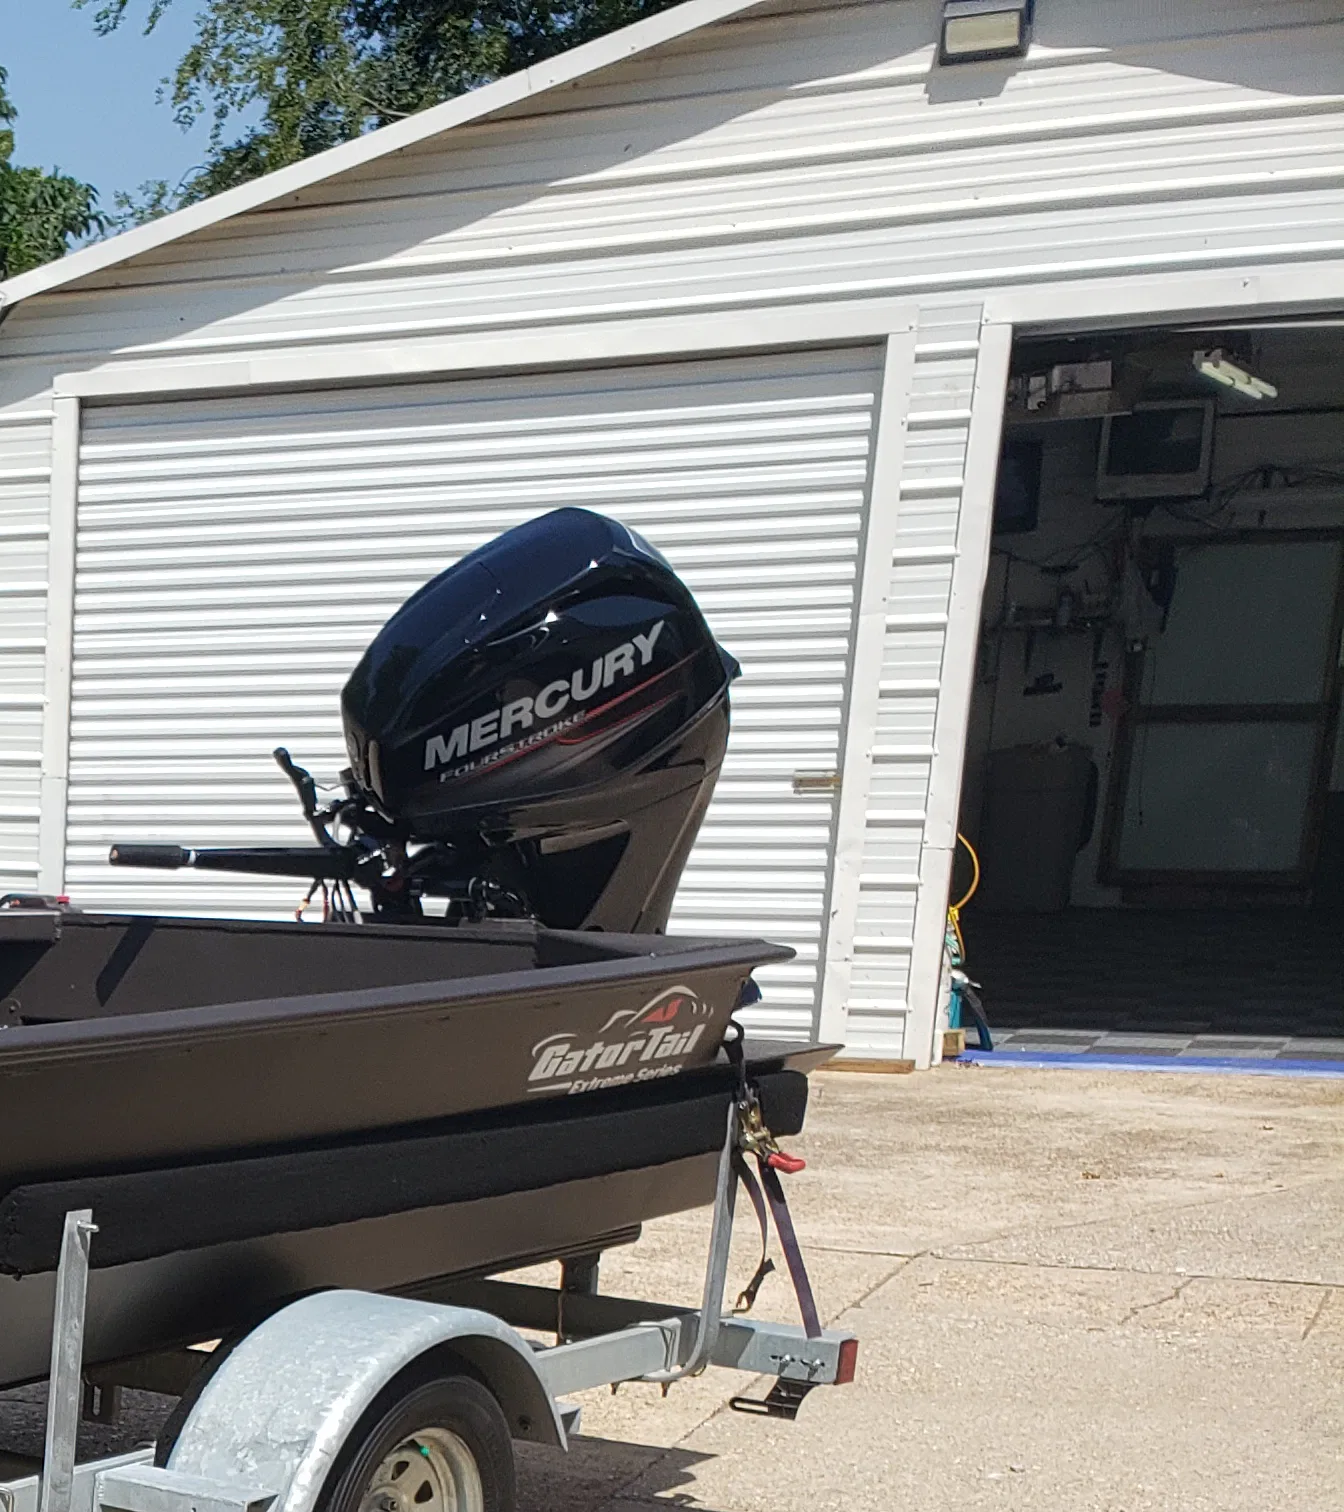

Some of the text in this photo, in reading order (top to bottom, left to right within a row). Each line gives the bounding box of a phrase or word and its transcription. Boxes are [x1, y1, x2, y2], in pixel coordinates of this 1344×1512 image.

[424, 620, 665, 771] MERCURY
[439, 710, 586, 783] FOURSTROKE
[568, 1063, 683, 1095] Extreme Series
